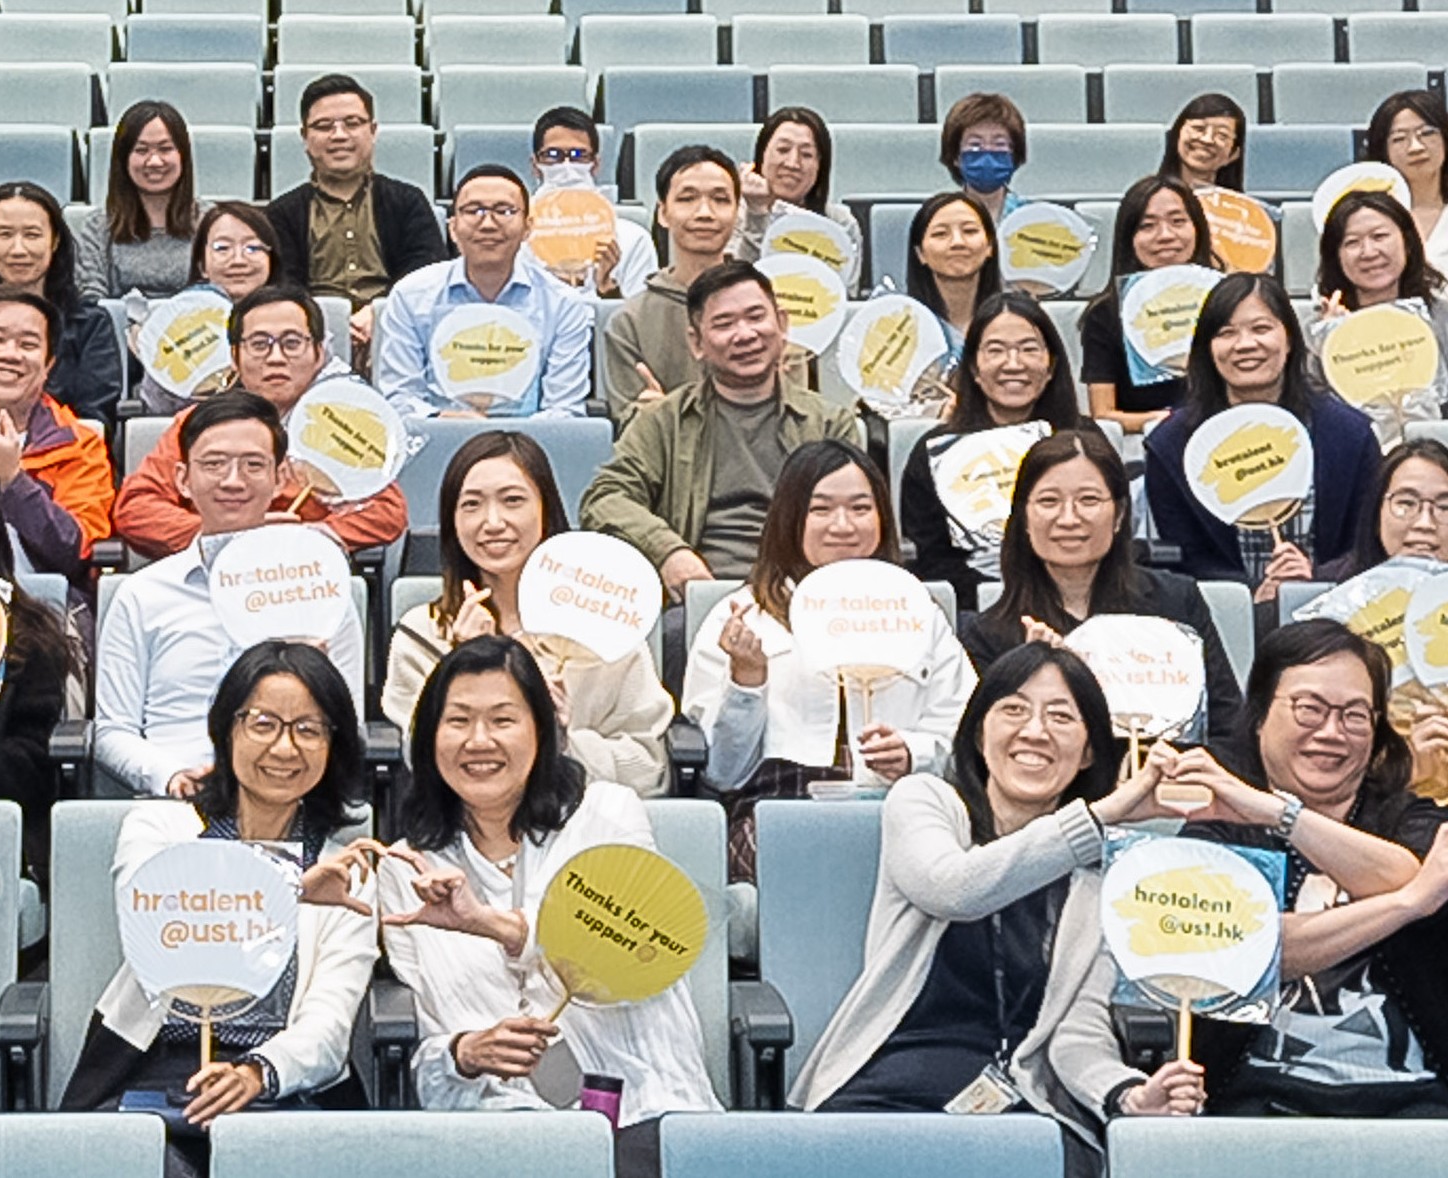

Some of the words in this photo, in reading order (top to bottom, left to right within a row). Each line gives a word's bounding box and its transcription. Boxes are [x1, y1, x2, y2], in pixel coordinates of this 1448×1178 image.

[549, 584, 645, 631] @ust.hk
[802, 594, 909, 612] hrtalent
[827, 615, 925, 637] @ust.hk
[565, 870, 623, 918] Thanks
[624, 908, 650, 933] for
[648, 927, 690, 957] your
[573, 908, 638, 953] support
[1158, 913, 1245, 942] @ust.hk
